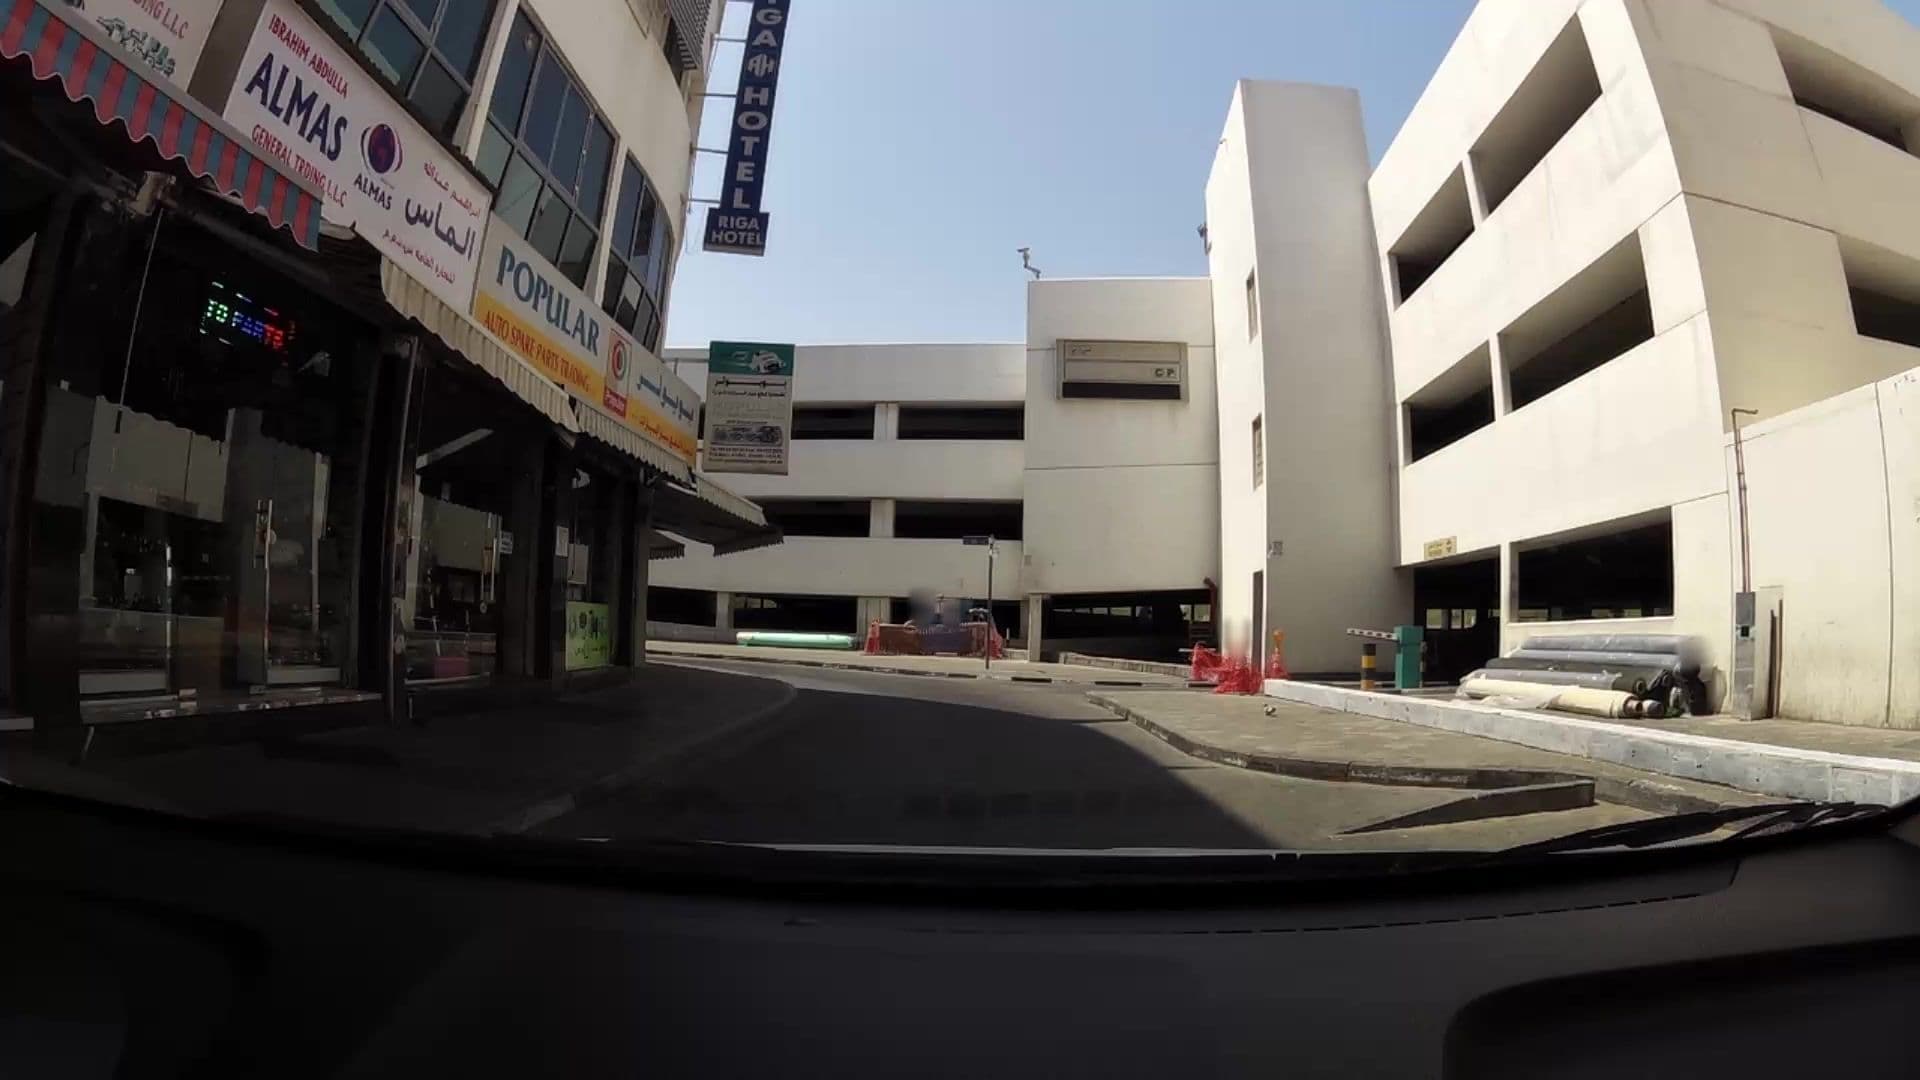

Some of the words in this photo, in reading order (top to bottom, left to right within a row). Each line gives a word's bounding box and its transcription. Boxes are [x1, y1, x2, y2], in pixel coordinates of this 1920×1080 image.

[268, 14, 311, 62] IBRAHIM
[308, 53, 349, 99] ABDULLA
[245, 52, 349, 162] ALMAS
[252, 123, 292, 168] GENERAL
[733, 86, 768, 209] HOTEL
[354, 173, 393, 211] ALMAS
[718, 215, 760, 230] RIGA
[405, 198, 477, 262] الماس
[711, 230, 764, 246] HOTEL
[496, 245, 601, 357] POPULAR
[484, 311, 510, 341] AUTO
[511, 326, 536, 358] SPARE
[536, 343, 559, 370] PARTS
